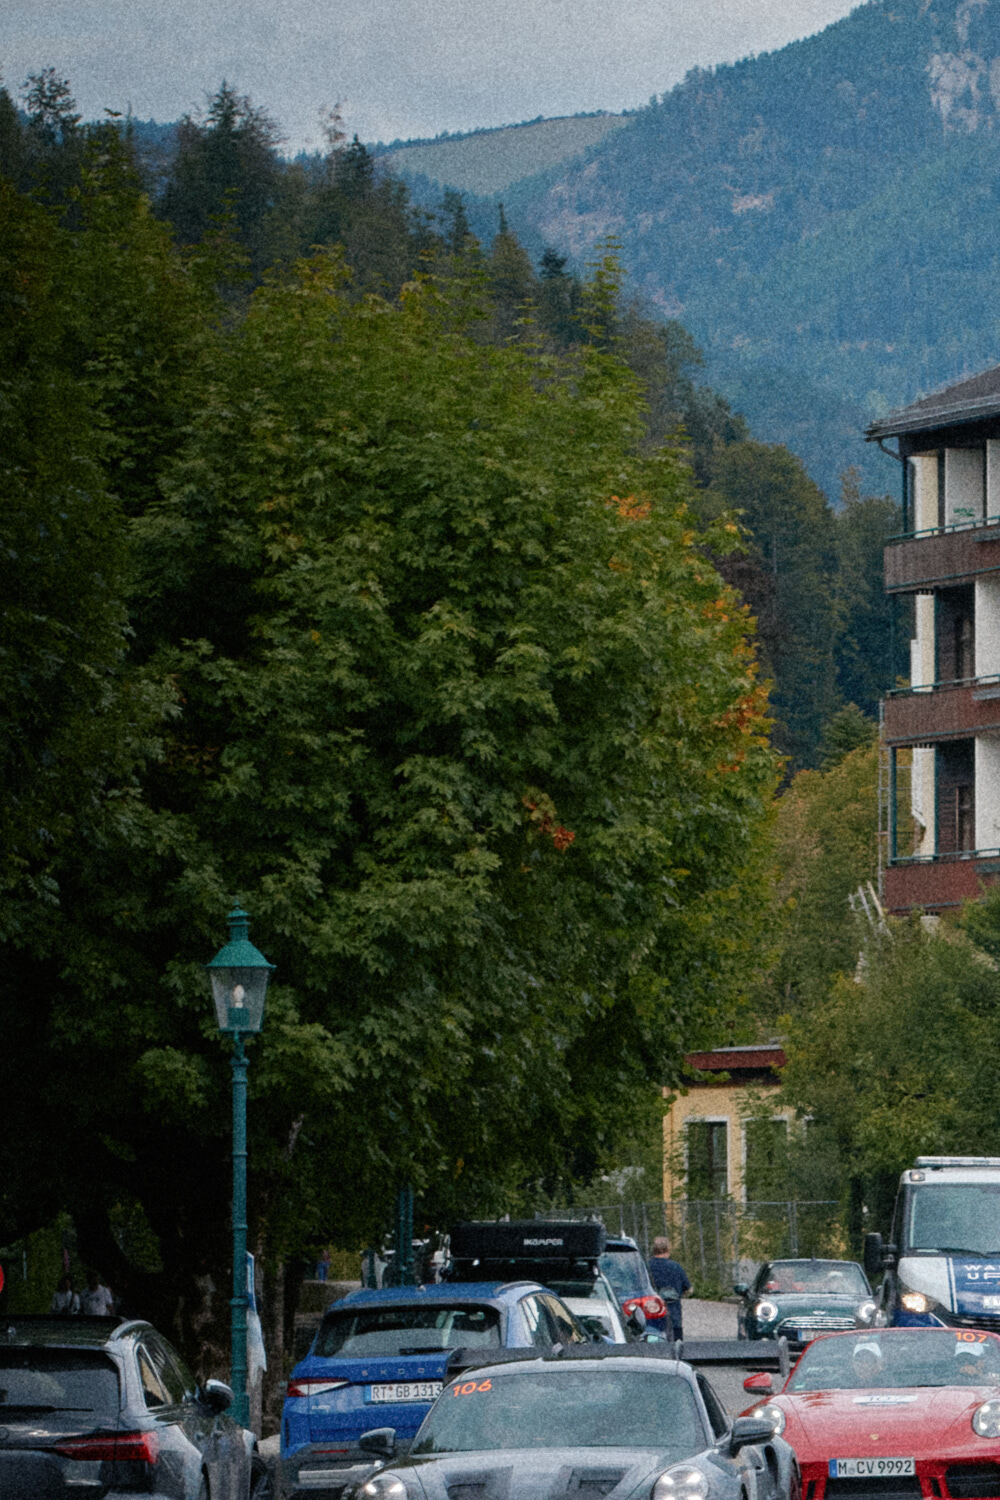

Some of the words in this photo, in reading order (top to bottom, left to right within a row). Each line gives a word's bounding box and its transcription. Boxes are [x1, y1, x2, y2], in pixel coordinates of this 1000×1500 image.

[955, 1332, 988, 1343] 107
[372, 1385, 387, 1398] RT
[396, 1385, 411, 1398] GB
[413, 1384, 441, 1398] 1313
[452, 1379, 493, 1397] 106
[838, 1462, 847, 1474] M
[856, 1461, 875, 1474] CV
[877, 1460, 912, 1474] 9992
